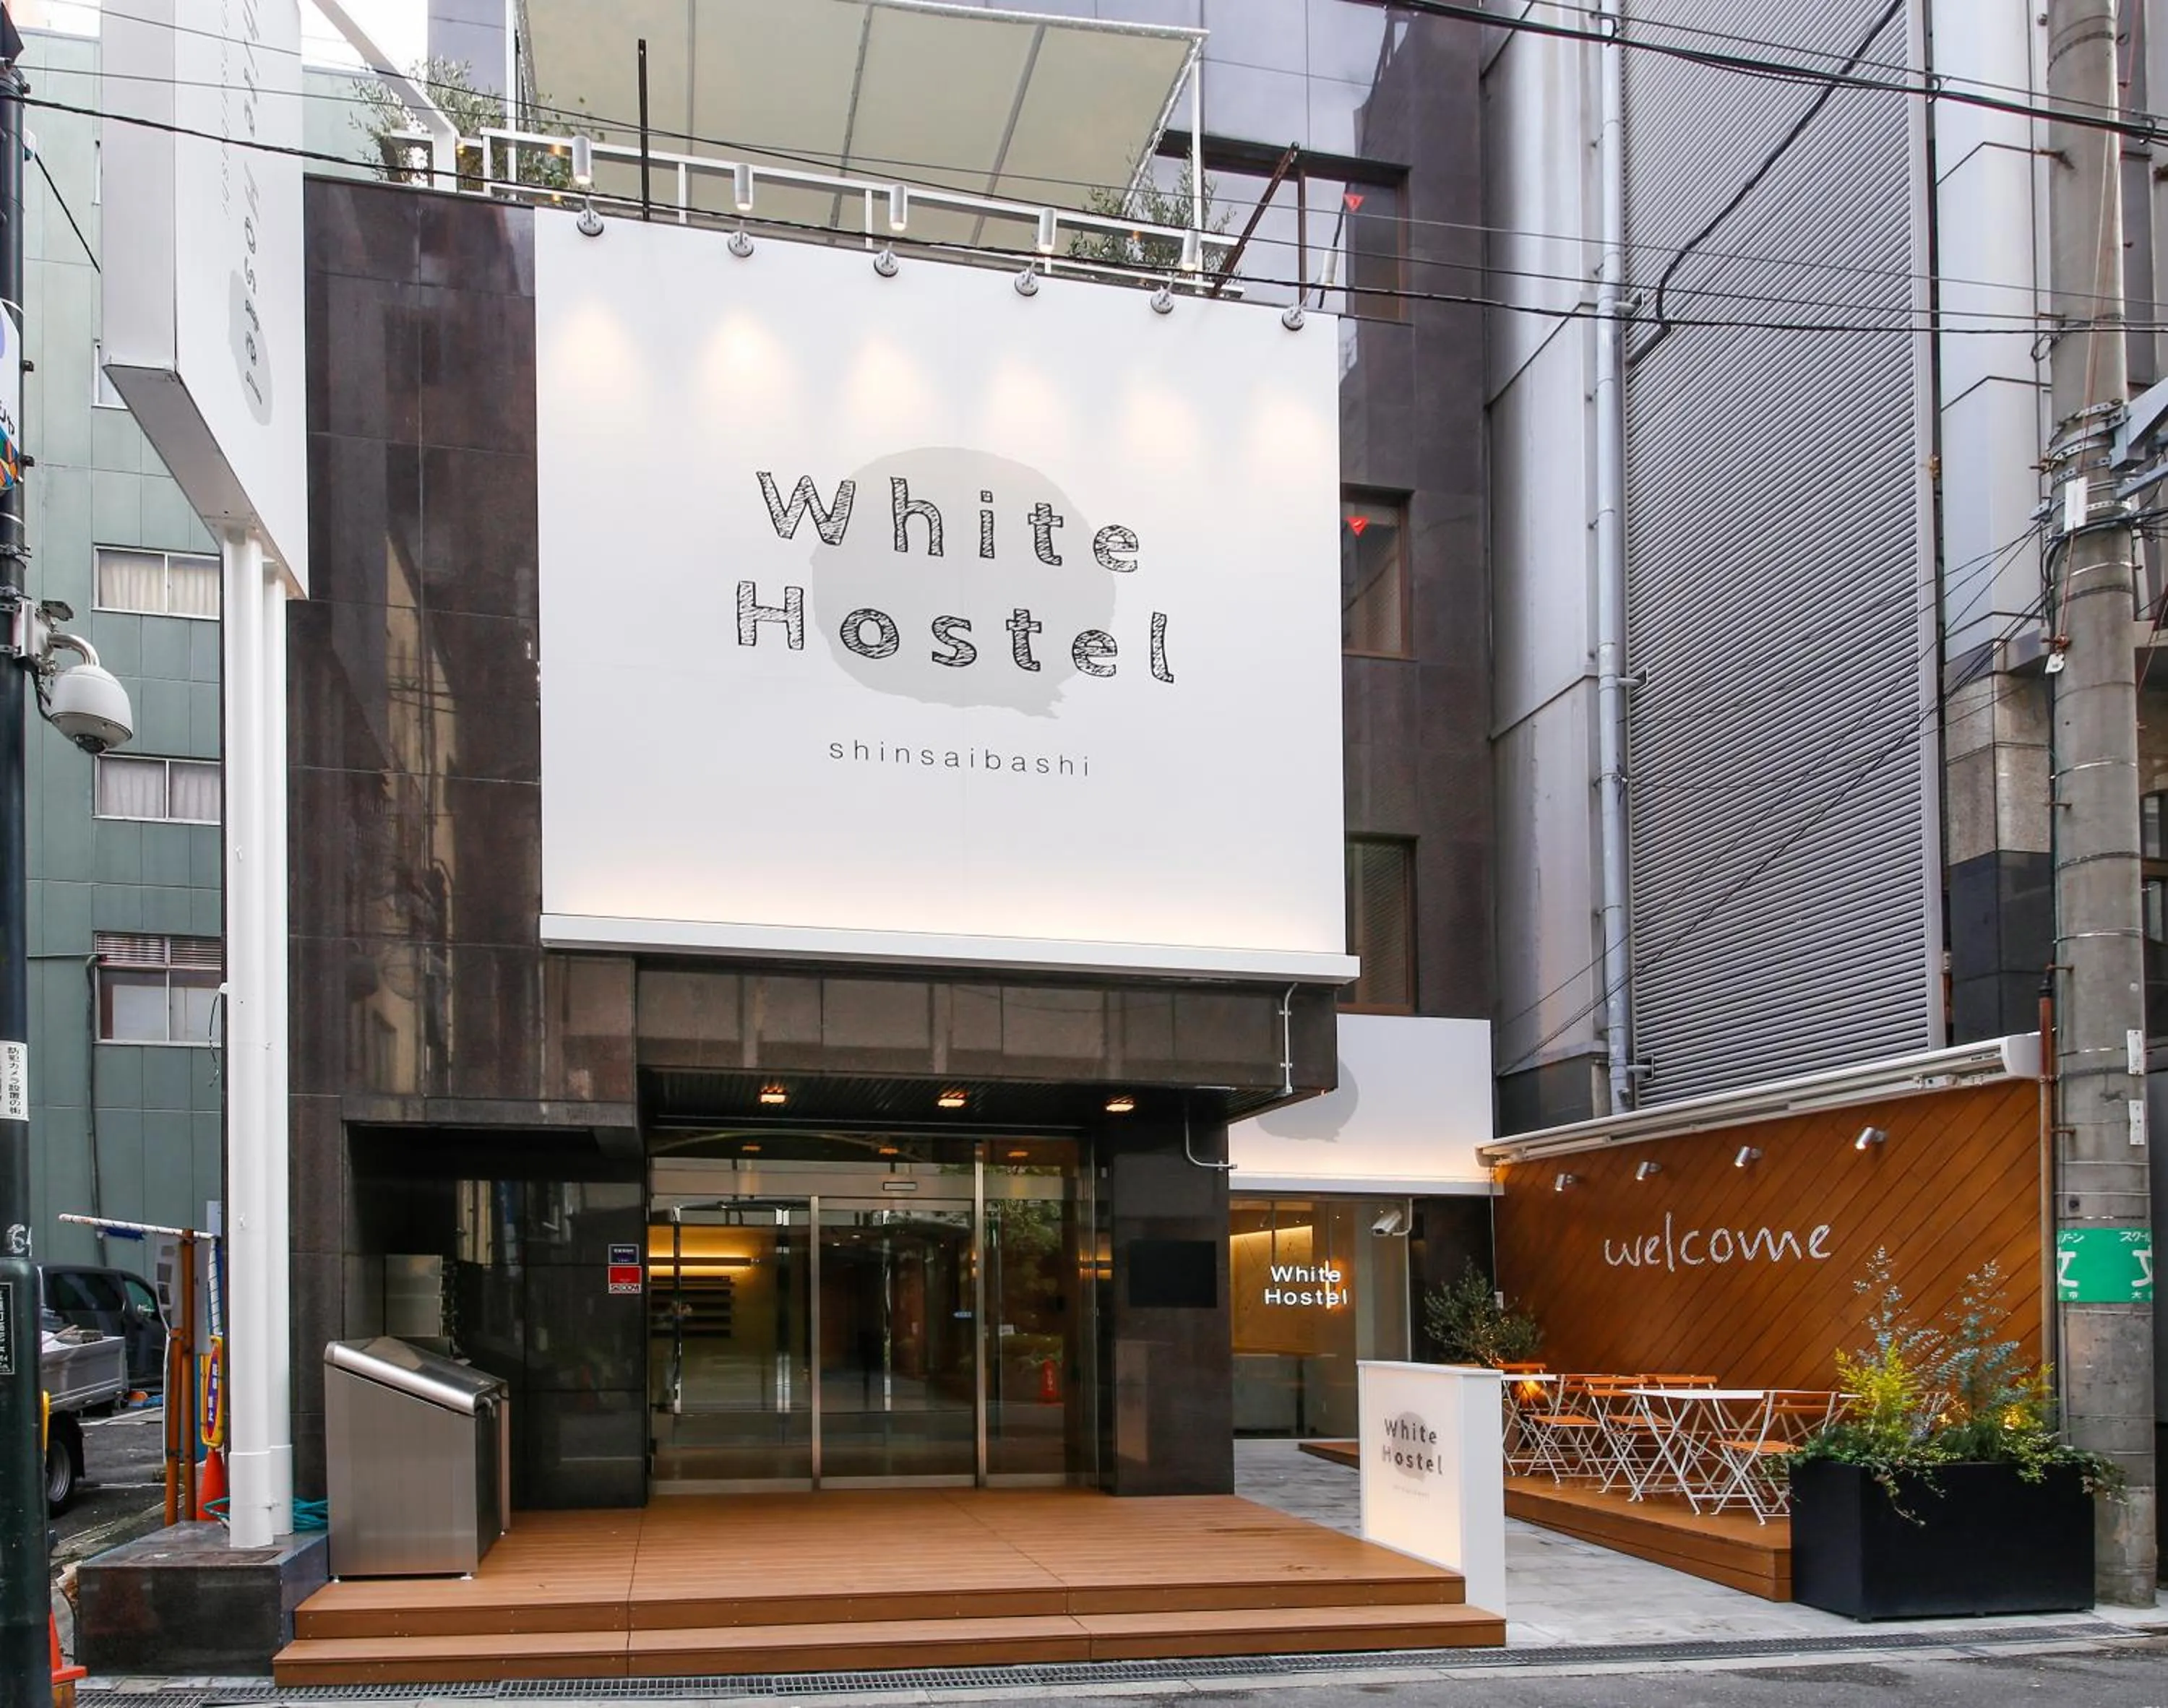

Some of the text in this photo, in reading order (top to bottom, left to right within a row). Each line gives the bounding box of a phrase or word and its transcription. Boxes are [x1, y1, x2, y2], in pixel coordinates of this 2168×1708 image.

[243, 0, 262, 405] hite Hostel
[756, 470, 1139, 573] White
[736, 579, 1174, 684] Hostel
[829, 739, 1089, 777] shinsaibashi
[1604, 1211, 1832, 1272] welcome
[1270, 1265, 1341, 1282] White
[1264, 1288, 1348, 1306] Hostel
[1383, 1418, 1437, 1445] White
[1382, 1444, 1443, 1475] Hostel
